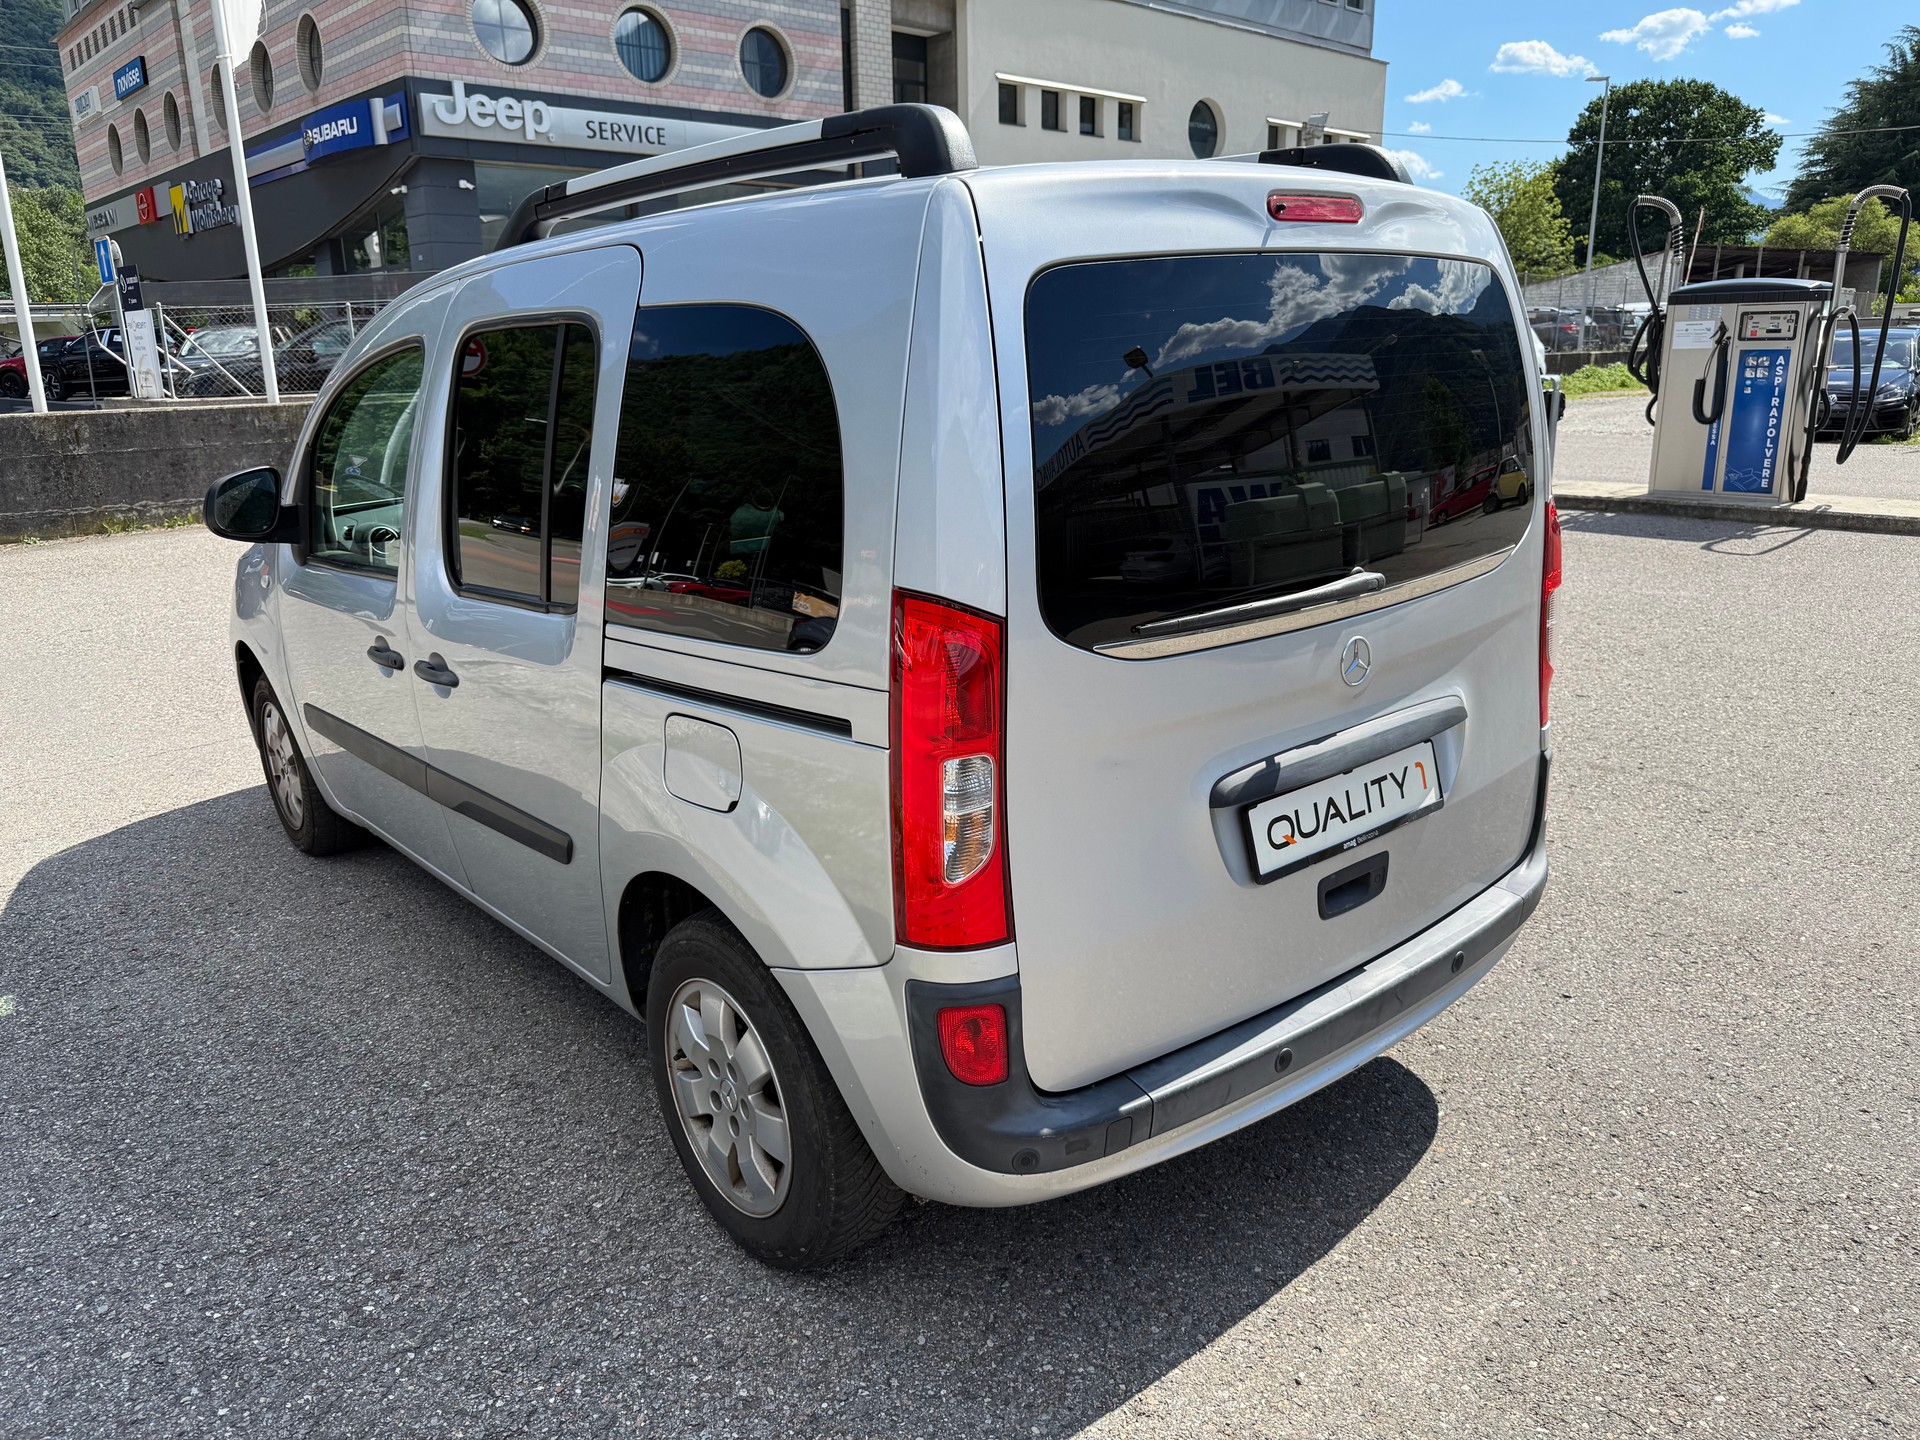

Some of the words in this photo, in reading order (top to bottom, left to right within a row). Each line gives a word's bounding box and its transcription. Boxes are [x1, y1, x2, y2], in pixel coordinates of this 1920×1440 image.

[116, 67, 141, 95] novisse
[434, 80, 552, 141] Jeep
[312, 116, 358, 145] SUBARU
[585, 120, 667, 146] SERVICE
[186, 179, 223, 204] Garage
[1760, 355, 1785, 488] ASPIRAPOLVERE
[1266, 765, 1408, 850] QUALITY
